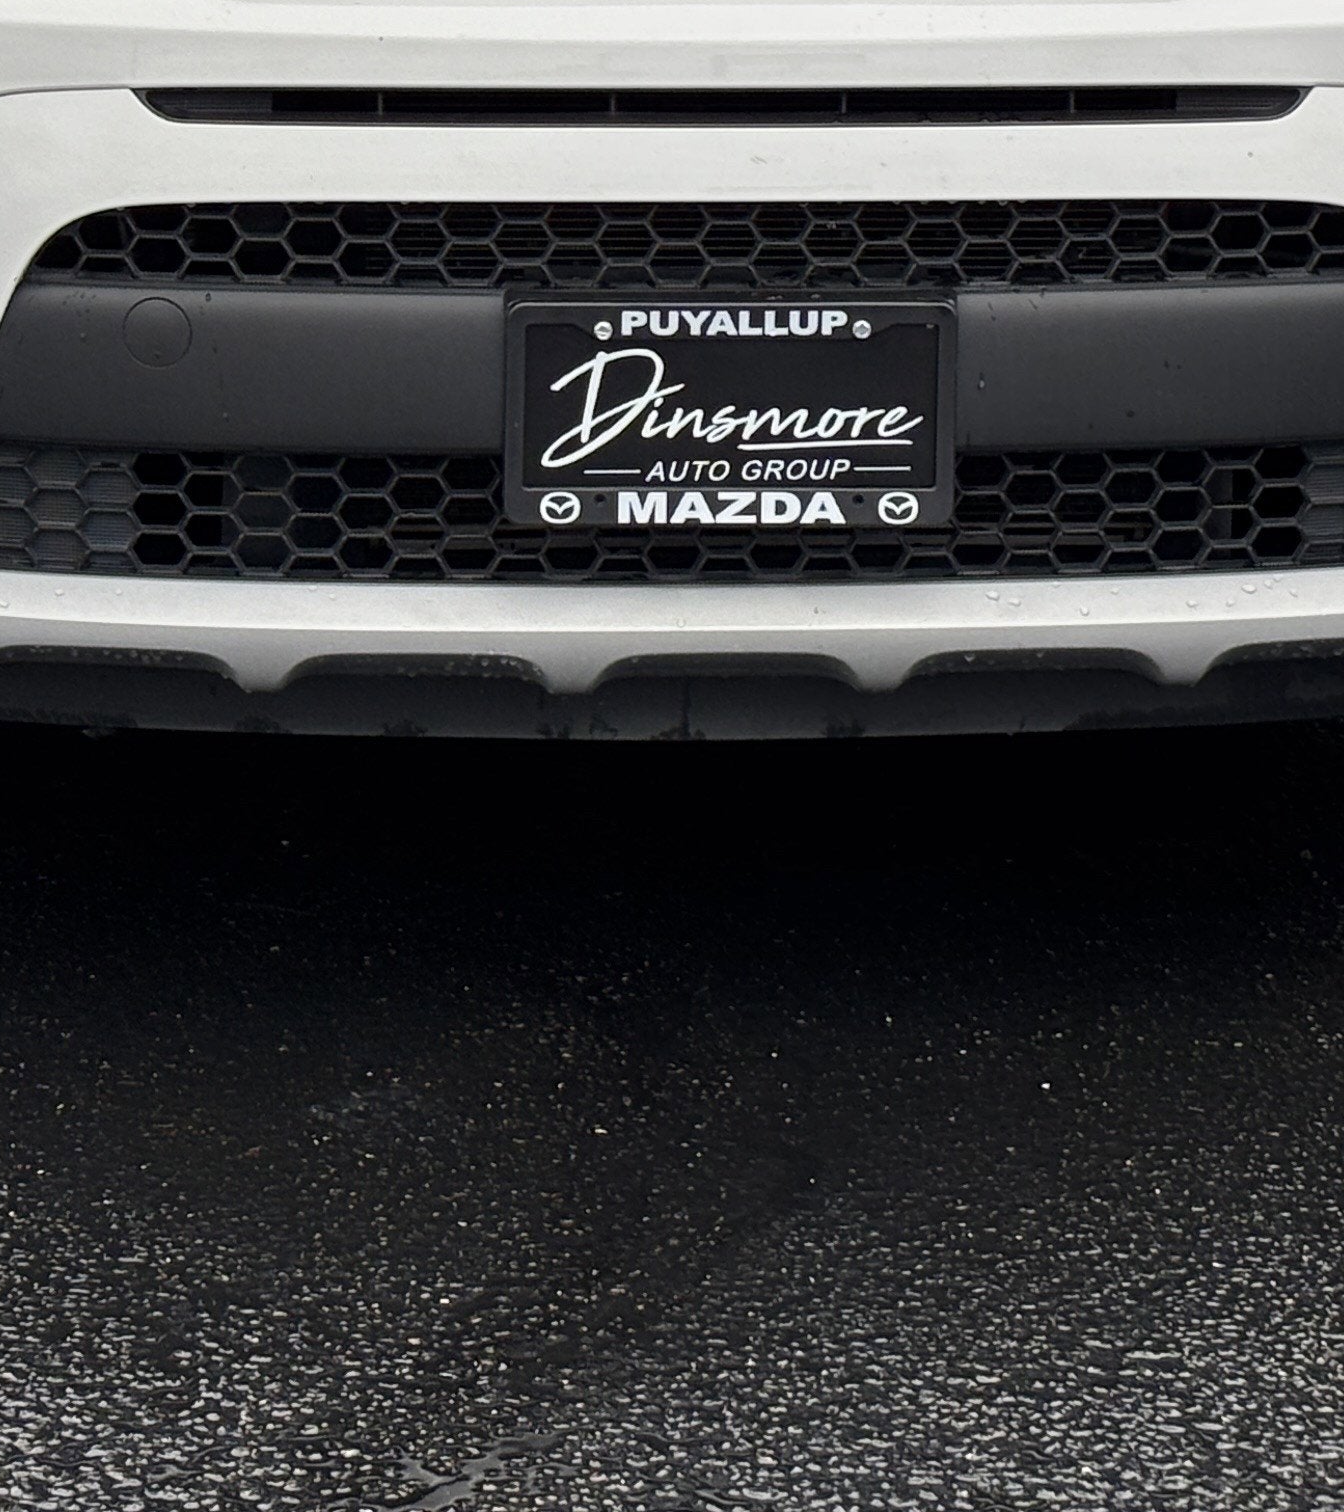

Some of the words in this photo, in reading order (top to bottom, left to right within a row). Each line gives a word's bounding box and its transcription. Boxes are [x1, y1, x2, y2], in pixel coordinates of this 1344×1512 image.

[620, 309, 849, 338] PUYALLUP
[540, 348, 924, 469] Dinsmore
[644, 460, 731, 483] AUTO
[741, 458, 852, 482] GROUP
[617, 491, 847, 525] MAZDA
